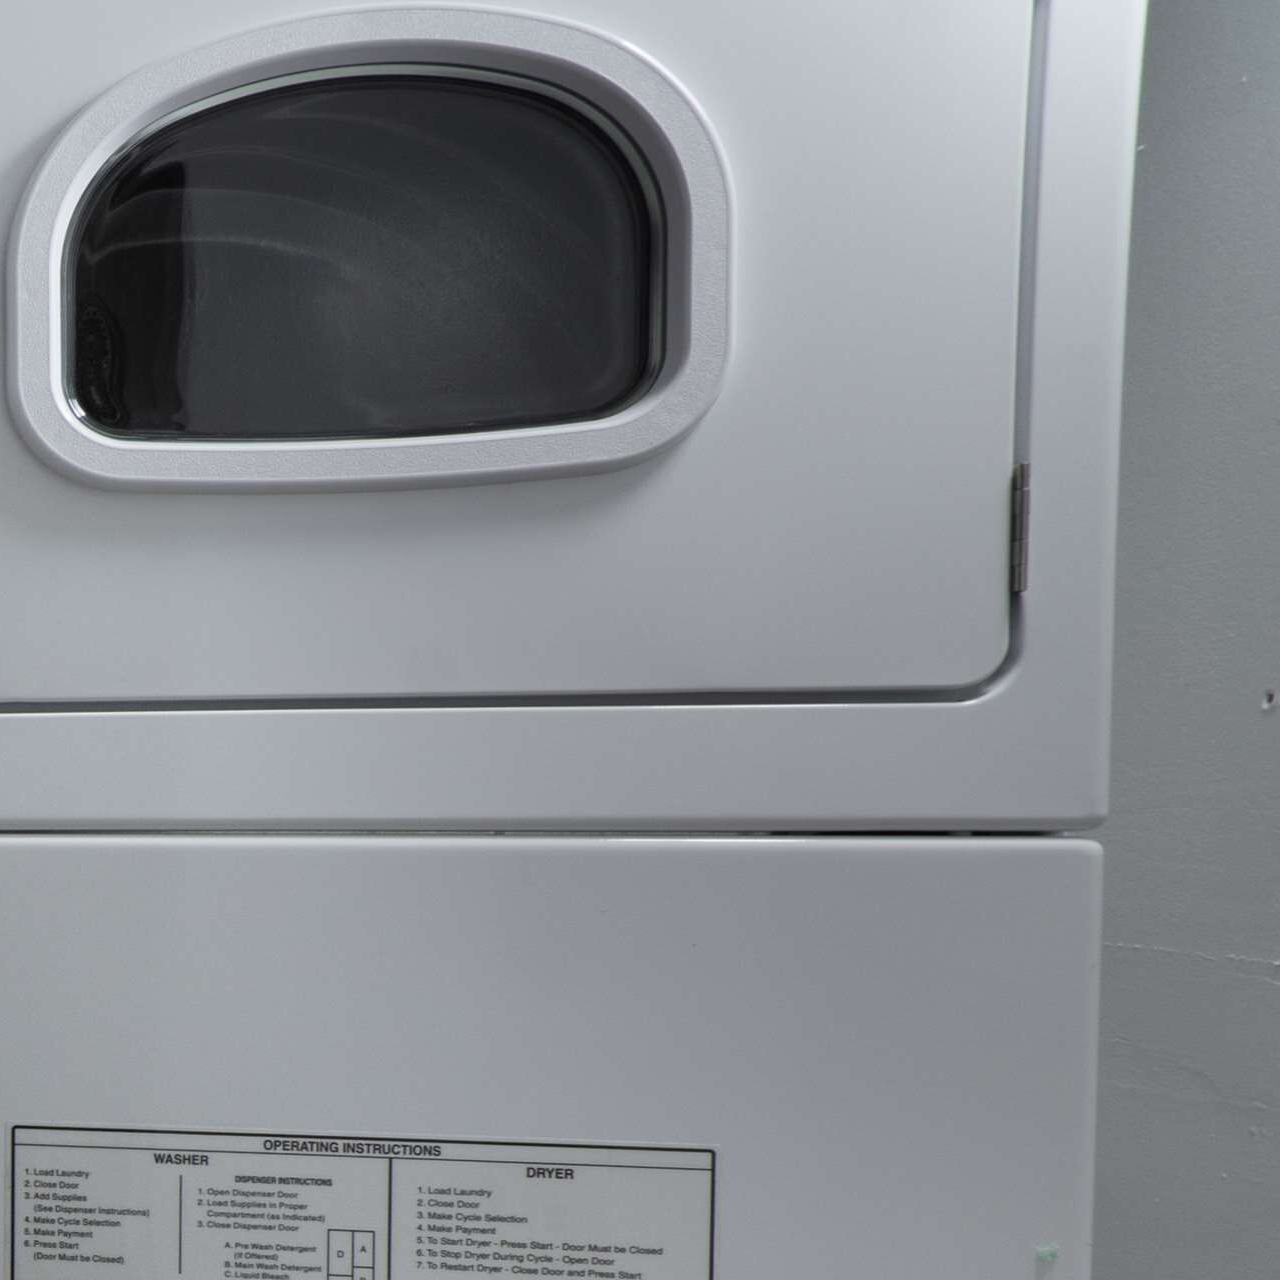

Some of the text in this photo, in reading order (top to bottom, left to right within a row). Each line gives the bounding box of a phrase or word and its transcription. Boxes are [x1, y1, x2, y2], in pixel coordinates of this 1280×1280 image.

[263, 1139, 441, 1157] OPERATING INSTRUCTIONS
[153, 1153, 209, 1166] WASHER
[56, 1170, 89, 1179] Laundry
[527, 1167, 574, 1179] DRYER
[235, 1176, 332, 1186] DISPENSER INSTRUCTIONS
[207, 1189, 230, 1197] Open
[233, 1189, 275, 1198] Dispenser
[428, 1187, 451, 1195] Load
[454, 1188, 492, 1197] Laundry
[52, 1194, 87, 1202] Supplies
[231, 1201, 267, 1209] Supplies
[279, 1203, 307, 1211] Proper
[428, 1200, 454, 1208] Close
[57, 1218, 80, 1226] Cycle
[83, 1218, 121, 1226] Selection
[428, 1212, 452, 1220] Make
[455, 1213, 481, 1222] Cycle
[485, 1214, 528, 1223] Selection
[233, 1222, 276, 1231] Dispenser
[428, 1225, 452, 1233] Make
[456, 1226, 496, 1235] Payment
[57, 1230, 93, 1238] Payment
[59, 1241, 79, 1249] Start
[441, 1238, 462, 1246] Start
[466, 1239, 490, 1248] Dryer
[501, 1240, 527, 1248] Press
[530, 1241, 553, 1249] Start
[562, 1243, 584, 1251] Door
[629, 1247, 663, 1255] Closed
[441, 1251, 461, 1259] Stop
[465, 1251, 489, 1260] Dryer
[493, 1252, 524, 1262] During
[527, 1254, 553, 1263] Cycle
[562, 1256, 588, 1265] Open
[592, 1257, 614, 1265] Door
[441, 1263, 473, 1271] Restart
[477, 1264, 502, 1273] Dryer
[512, 1266, 538, 1274] Close
[542, 1267, 564, 1275] Door
[588, 1270, 615, 1279] Press
[618, 1272, 642, 1280] Start
